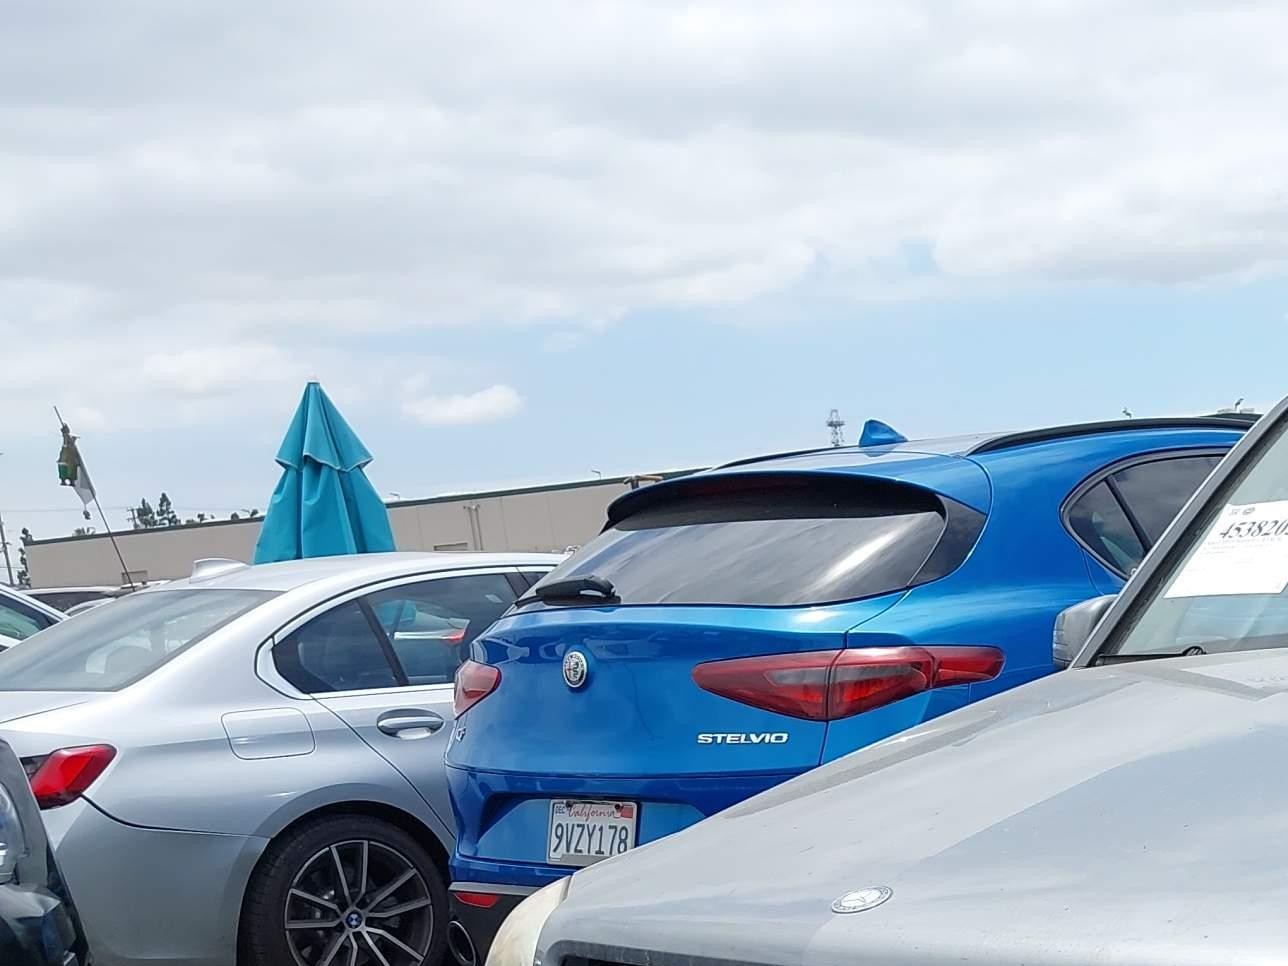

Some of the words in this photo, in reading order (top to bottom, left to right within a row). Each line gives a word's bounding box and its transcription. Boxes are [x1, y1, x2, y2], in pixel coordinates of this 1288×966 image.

[697, 732, 789, 744] STELVIO
[567, 804, 615, 821] California
[553, 822, 629, 855] 9VZY178
